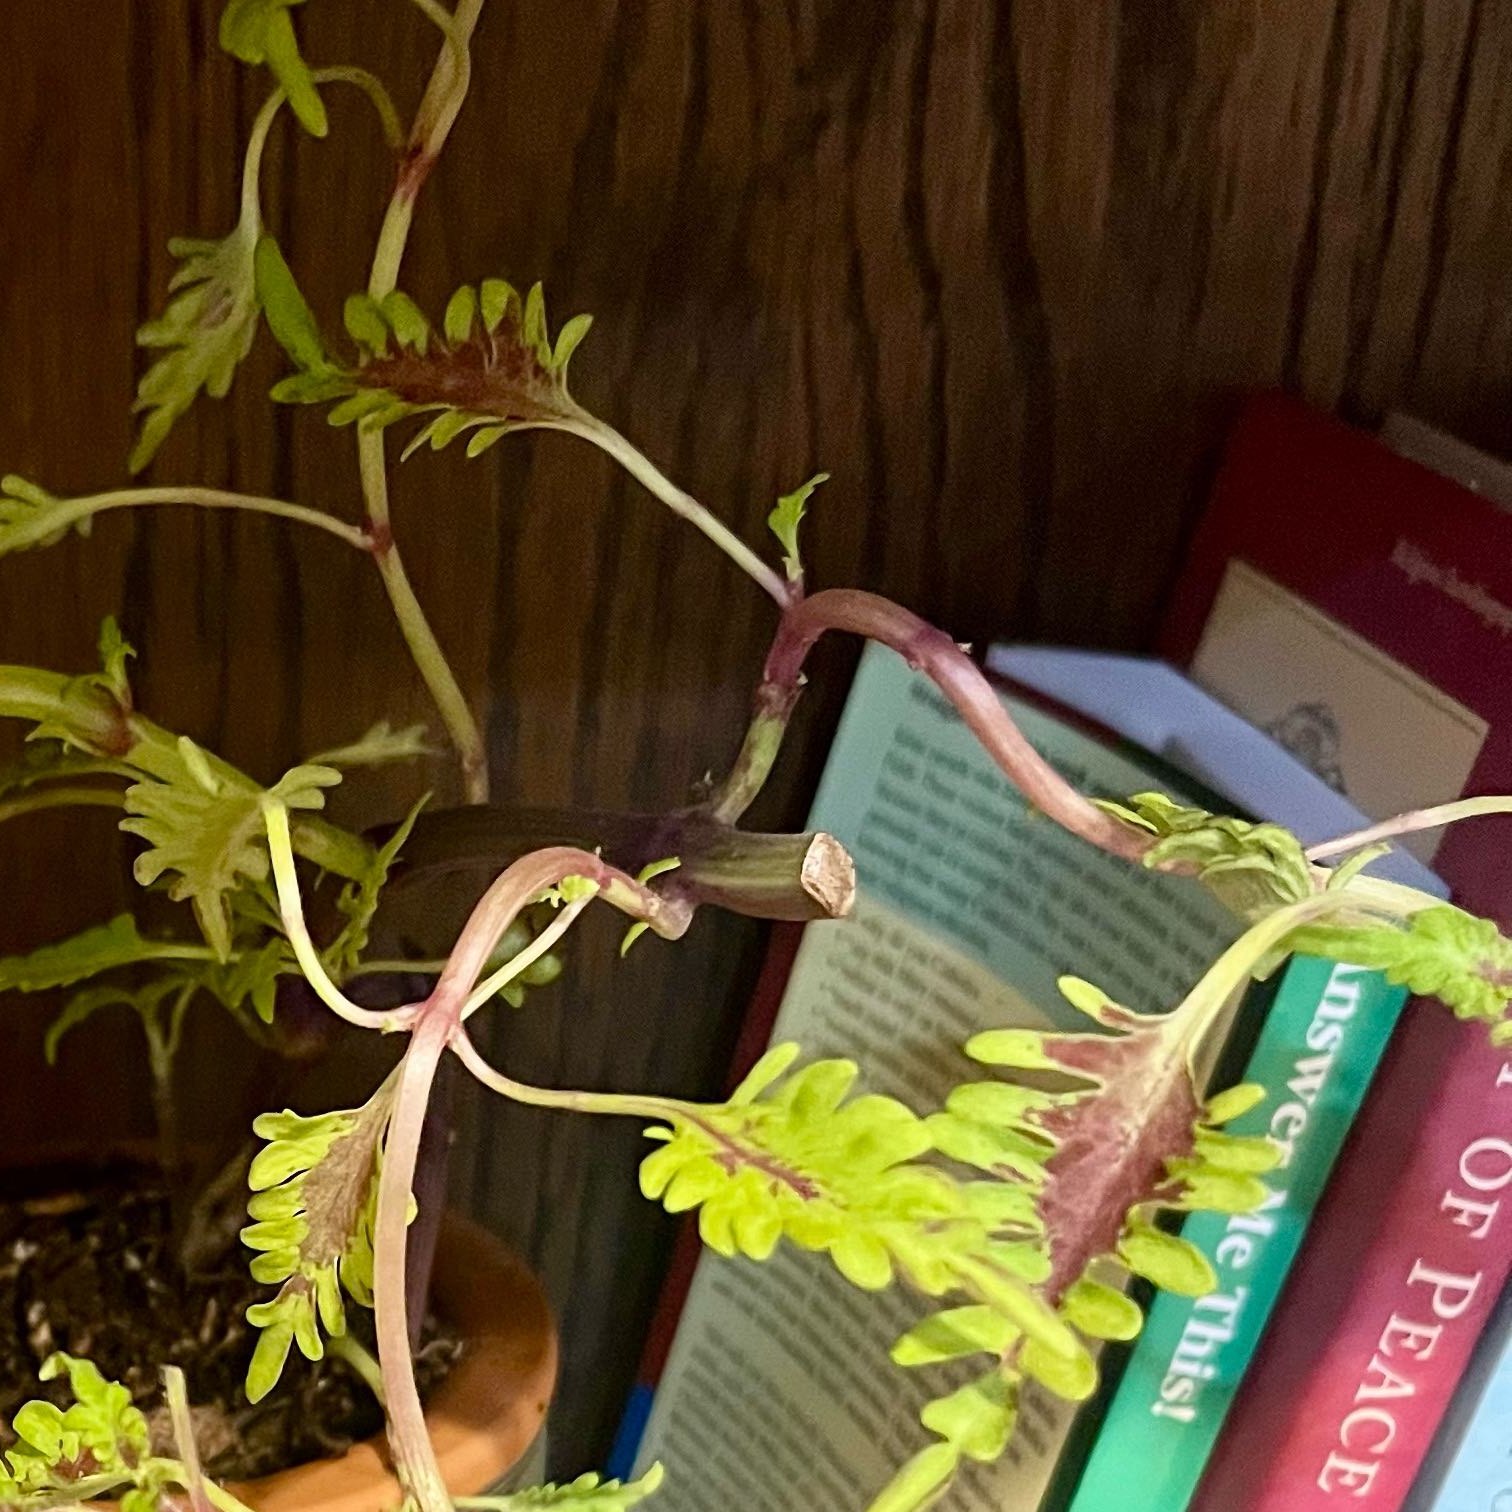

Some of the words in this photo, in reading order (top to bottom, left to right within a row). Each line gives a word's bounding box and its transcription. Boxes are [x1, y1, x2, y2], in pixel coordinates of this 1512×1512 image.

[1440, 1137, 1512, 1240] OF
[1151, 1286, 1249, 1424] This!
[1317, 1257, 1484, 1497] PEACE
